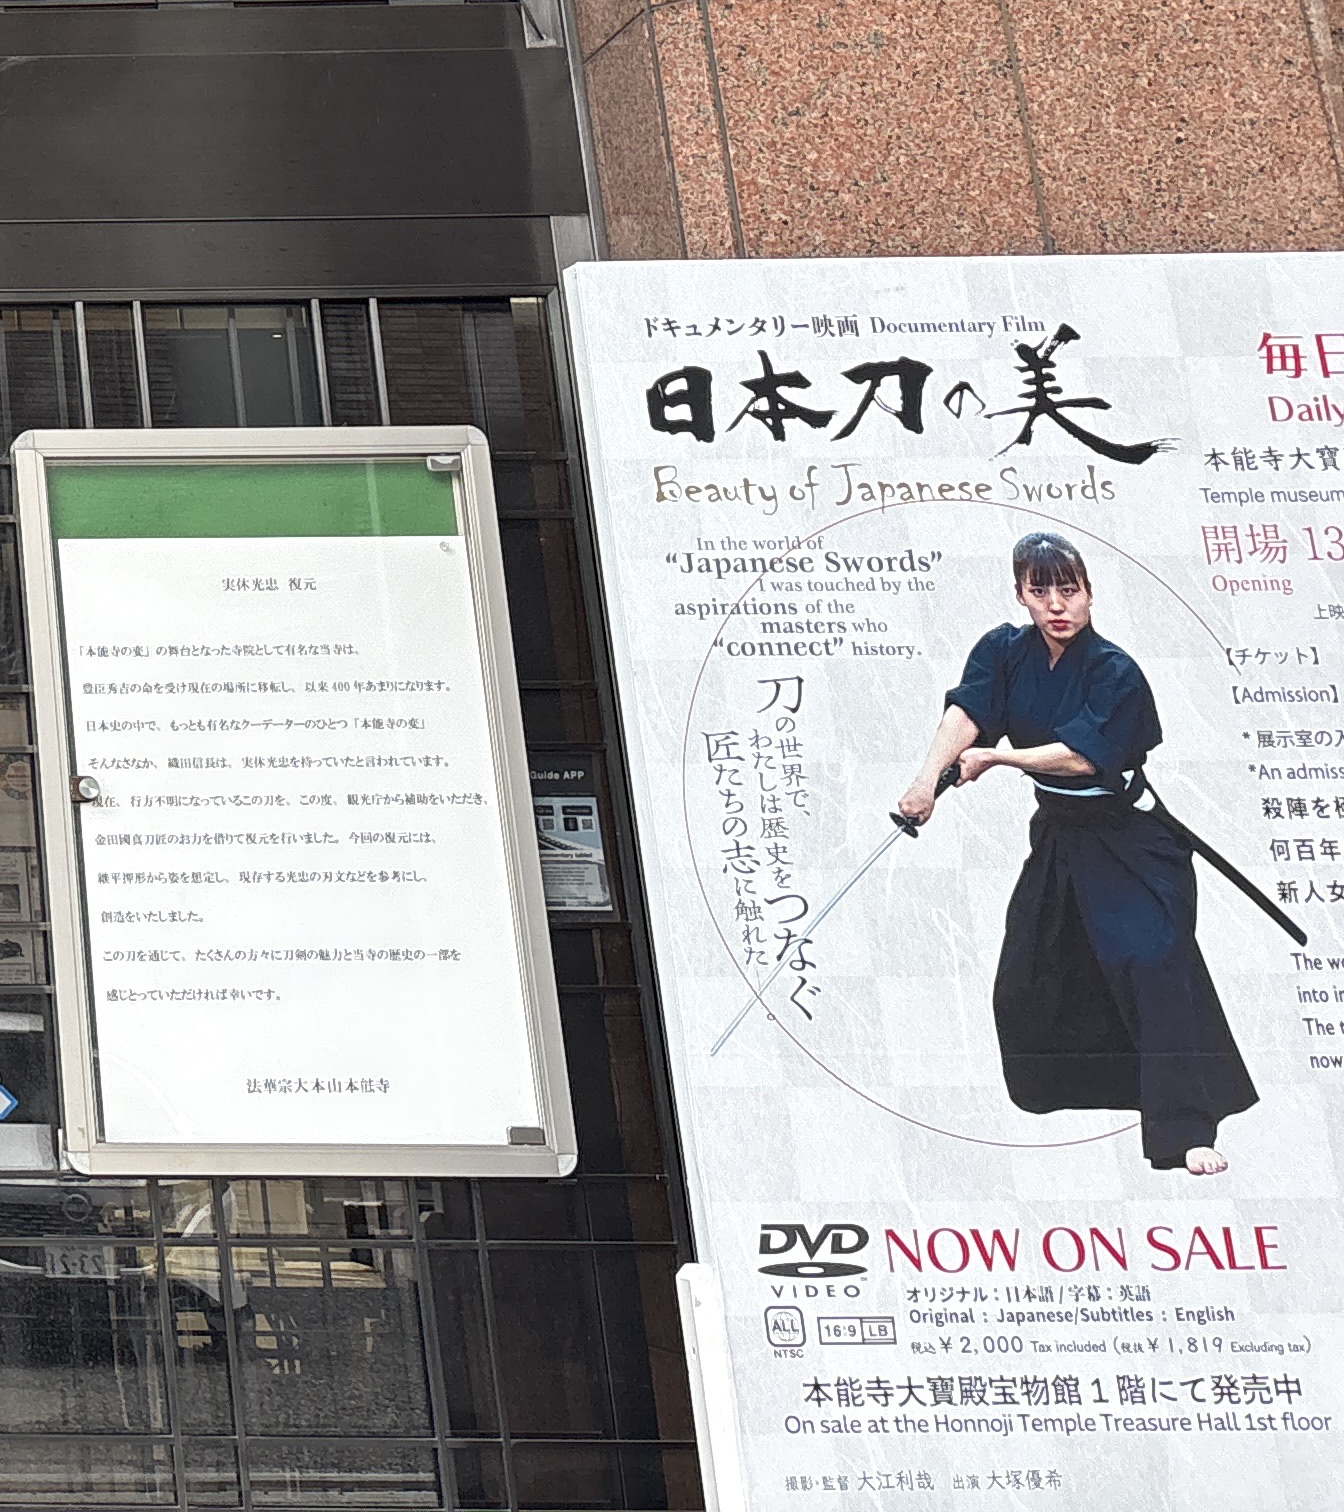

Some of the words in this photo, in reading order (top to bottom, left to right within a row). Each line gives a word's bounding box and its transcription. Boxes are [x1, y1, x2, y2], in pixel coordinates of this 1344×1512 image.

[644, 314, 860, 339] ドキュメンタリー映画
[869, 316, 996, 338] Documentary
[1002, 315, 1046, 333] Film
[1257, 332, 1344, 378] 毎日
[646, 323, 1183, 465] 日本刀の美
[1268, 395, 1344, 427] Daily
[1204, 445, 1344, 472] 本能寺大寶
[654, 465, 778, 516] Beauty
[790, 465, 820, 510] of
[831, 463, 993, 514] Japanese
[1000, 465, 1115, 504] Swords
[1199, 487, 1265, 507] Temple
[1271, 489, 1344, 503] museum
[697, 538, 716, 551] In
[721, 536, 747, 551] the
[752, 536, 800, 551] world
[807, 536, 825, 550] of
[1201, 523, 1288, 565] 開場
[666, 552, 814, 579] “Japanese
[825, 550, 942, 573] Swords”
[771, 580, 802, 592] was
[807, 577, 876, 592] touched
[881, 577, 902, 595] by
[908, 577, 935, 591] the
[1212, 575, 1294, 596] Opening
[675, 598, 798, 620] aspirations
[806, 599, 823, 614] of
[828, 599, 855, 614] the
[761, 619, 847, 634] masters
[852, 618, 888, 633] who
[714, 637, 844, 657] “connect”
[852, 641, 922, 659] history.
[1224, 647, 1320, 666] 【チケット】
[563, 770, 585, 780] APP
[701, 730, 769, 966] 匠たちの志に触れた
[1270, 838, 1341, 862] 何百年
[748, 728, 821, 1021] わたしは歴史をつなぐ
[1277, 880, 1344, 903] 新人女
[1290, 952, 1322, 970] The
[1297, 986, 1328, 1003] into
[1302, 1018, 1335, 1036] The
[759, 1224, 870, 1260] DVD
[884, 1228, 1020, 1273] NOW
[1042, 1226, 1128, 1272] ON
[1146, 1225, 1287, 1272] SALE
[770, 1285, 861, 1298] VIDEO
[909, 1309, 975, 1327] Original
[996, 1307, 1154, 1327] Japanese/Subtitles
[1175, 1306, 1235, 1325] English
[771, 1321, 800, 1334] ALL
[824, 1325, 857, 1338] 16:9
[868, 1325, 889, 1337] LB
[774, 1349, 805, 1358] NTSC
[1031, 1340, 1053, 1353] Tax
[1055, 1339, 1107, 1353] included
[1231, 1340, 1285, 1355] Excluding
[1288, 1335, 1312, 1353] tax)
[785, 1415, 814, 1434] On
[820, 1414, 862, 1434] sale
[868, 1416, 890, 1433] at
[894, 1414, 930, 1433] the
[934, 1413, 1013, 1436] Honnoji
[1017, 1412, 1096, 1436] Temple
[1100, 1413, 1192, 1432] Treasure
[1197, 1412, 1241, 1432] Hall
[1245, 1412, 1278, 1432] 1st
[1281, 1411, 1332, 1431] floor
